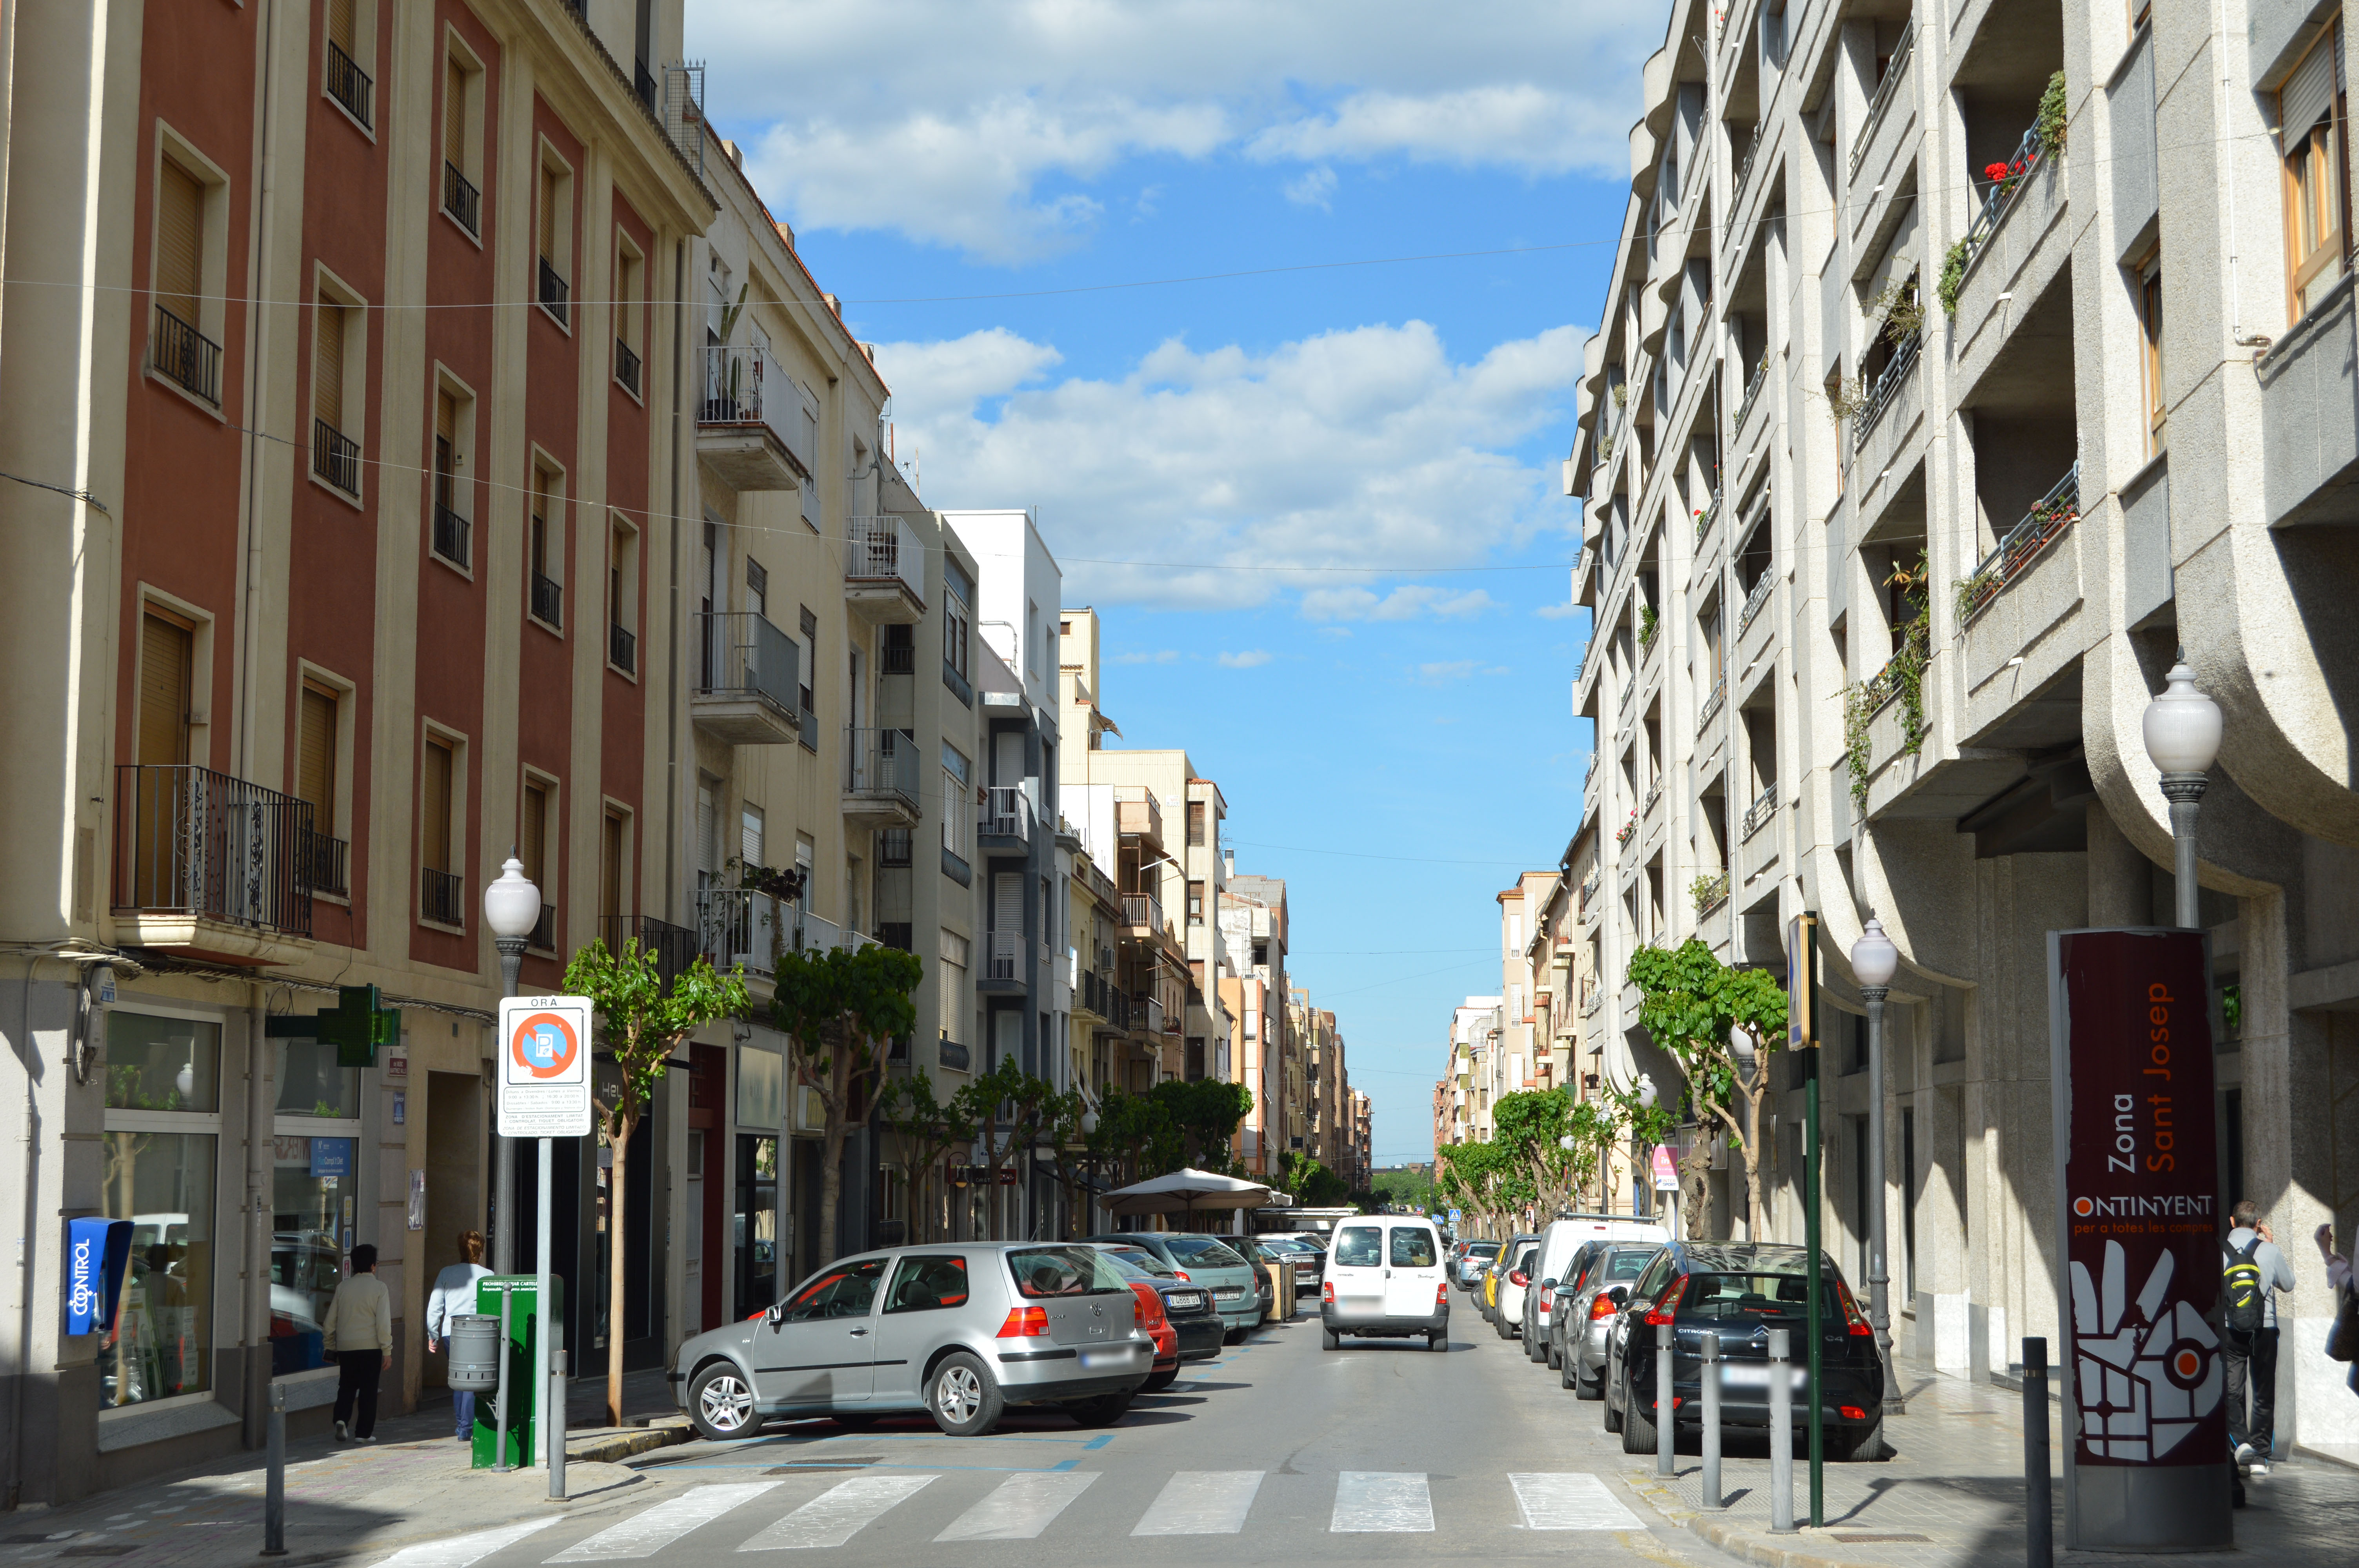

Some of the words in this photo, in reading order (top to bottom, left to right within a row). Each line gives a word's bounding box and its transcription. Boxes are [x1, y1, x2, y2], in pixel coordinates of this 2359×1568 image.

[2143, 982, 2174, 1081] Josep
[538, 1036, 551, 1054] P
[2108, 1094, 2135, 1174] Zona
[2146, 1094, 2174, 1172] Sant
[2073, 1195, 2213, 1217] ONTINYENT
[2074, 1223, 2095, 1236] per
[2100, 1224, 2108, 1233] a
[2112, 1221, 2144, 1233] totes
[2149, 1221, 2165, 1233] les
[2170, 1223, 2214, 1236] compres
[1176, 1295, 1190, 1305] 4888
[1191, 1294, 1199, 1303] GV
